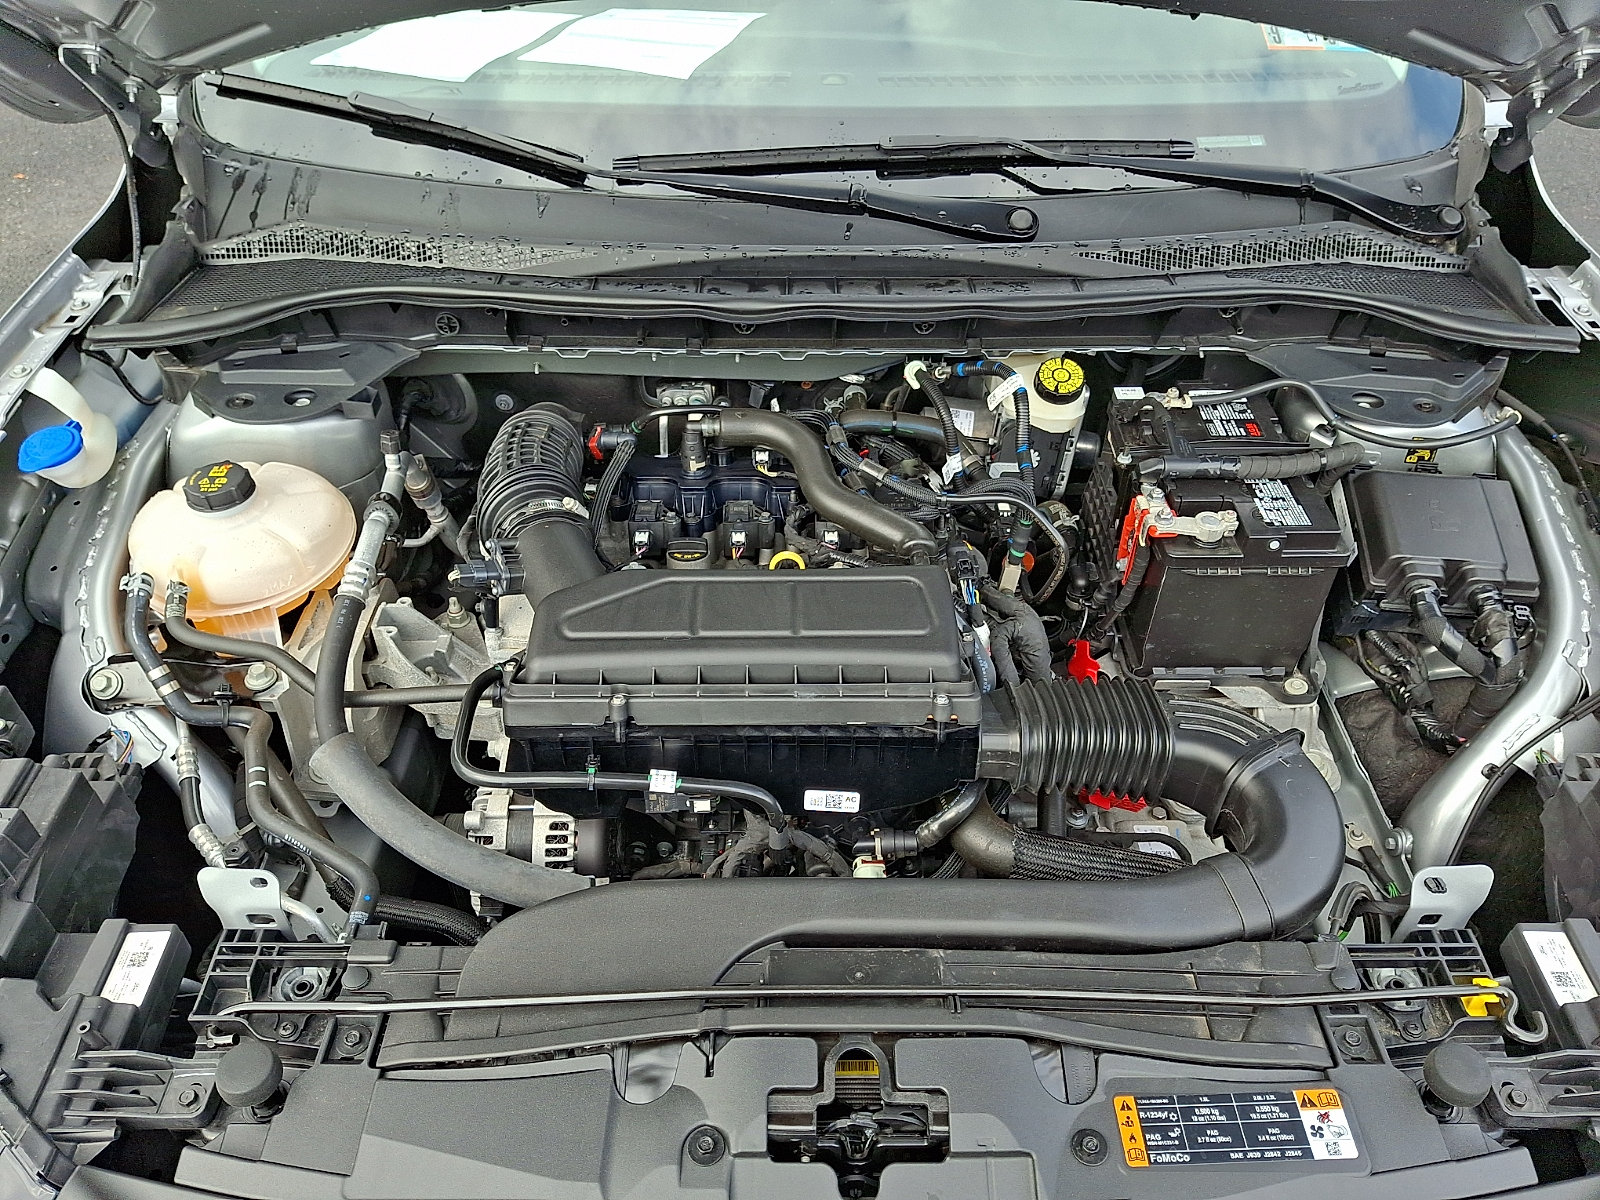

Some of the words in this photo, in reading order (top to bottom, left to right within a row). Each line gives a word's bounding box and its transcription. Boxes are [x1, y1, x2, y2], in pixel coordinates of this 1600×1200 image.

[1254, 1105, 1271, 1113] 0.550
[1271, 1105, 1280, 1113] kg
[1139, 1111, 1169, 1120] R-1234yf
[1145, 1133, 1161, 1141] PAG
[1150, 1154, 1191, 1163] FoMoCo
